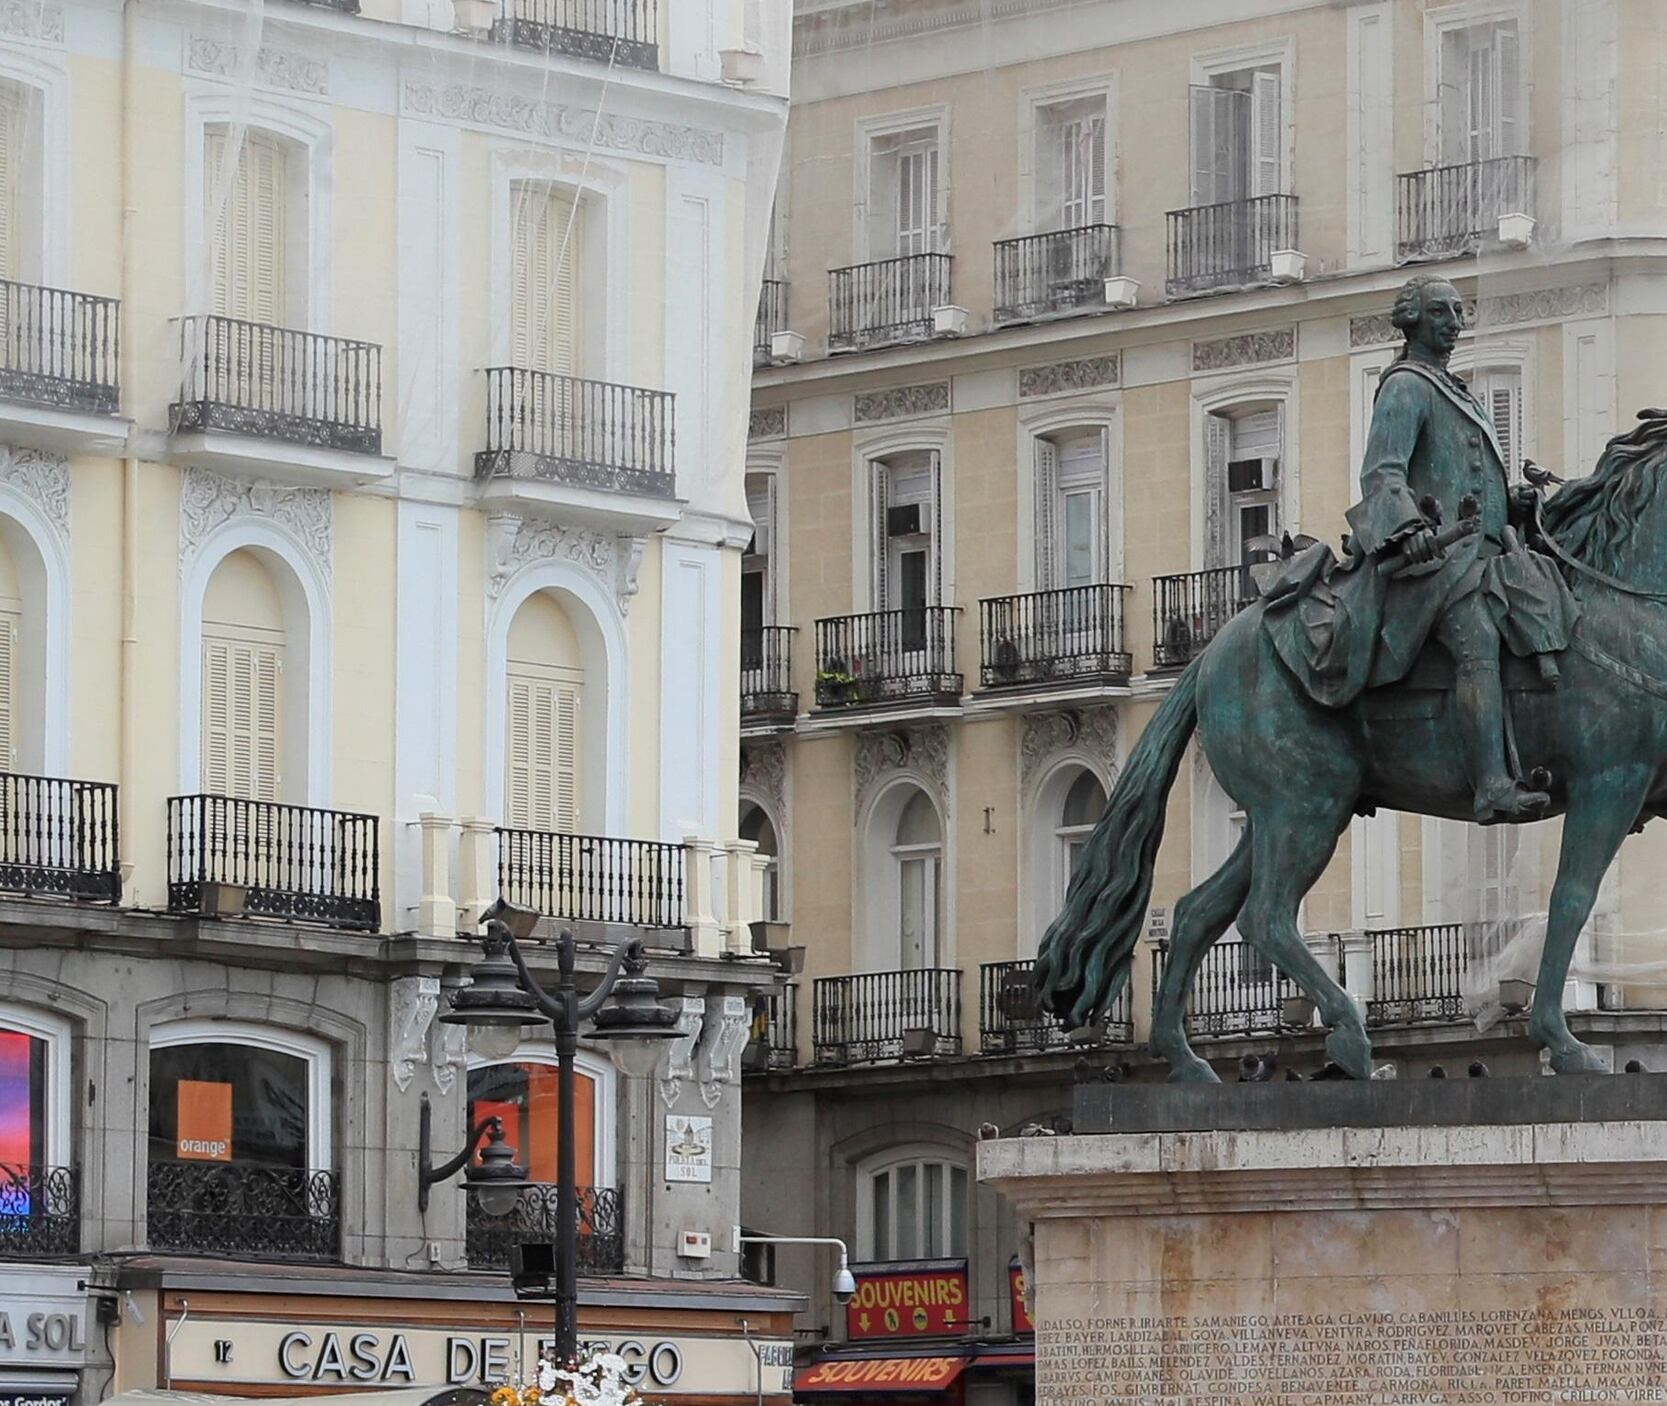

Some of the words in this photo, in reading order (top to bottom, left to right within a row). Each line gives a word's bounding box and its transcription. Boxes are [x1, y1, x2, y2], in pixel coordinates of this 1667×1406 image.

[180, 1139, 226, 1158] orange
[850, 1278, 963, 1310] SOUVENIRS
[27, 1312, 87, 1350] SOL
[214, 1339, 234, 1363] 12
[278, 1331, 416, 1382] CASA
[446, 1336, 511, 1384] DE
[807, 1357, 960, 1384] SOUVENIRS
